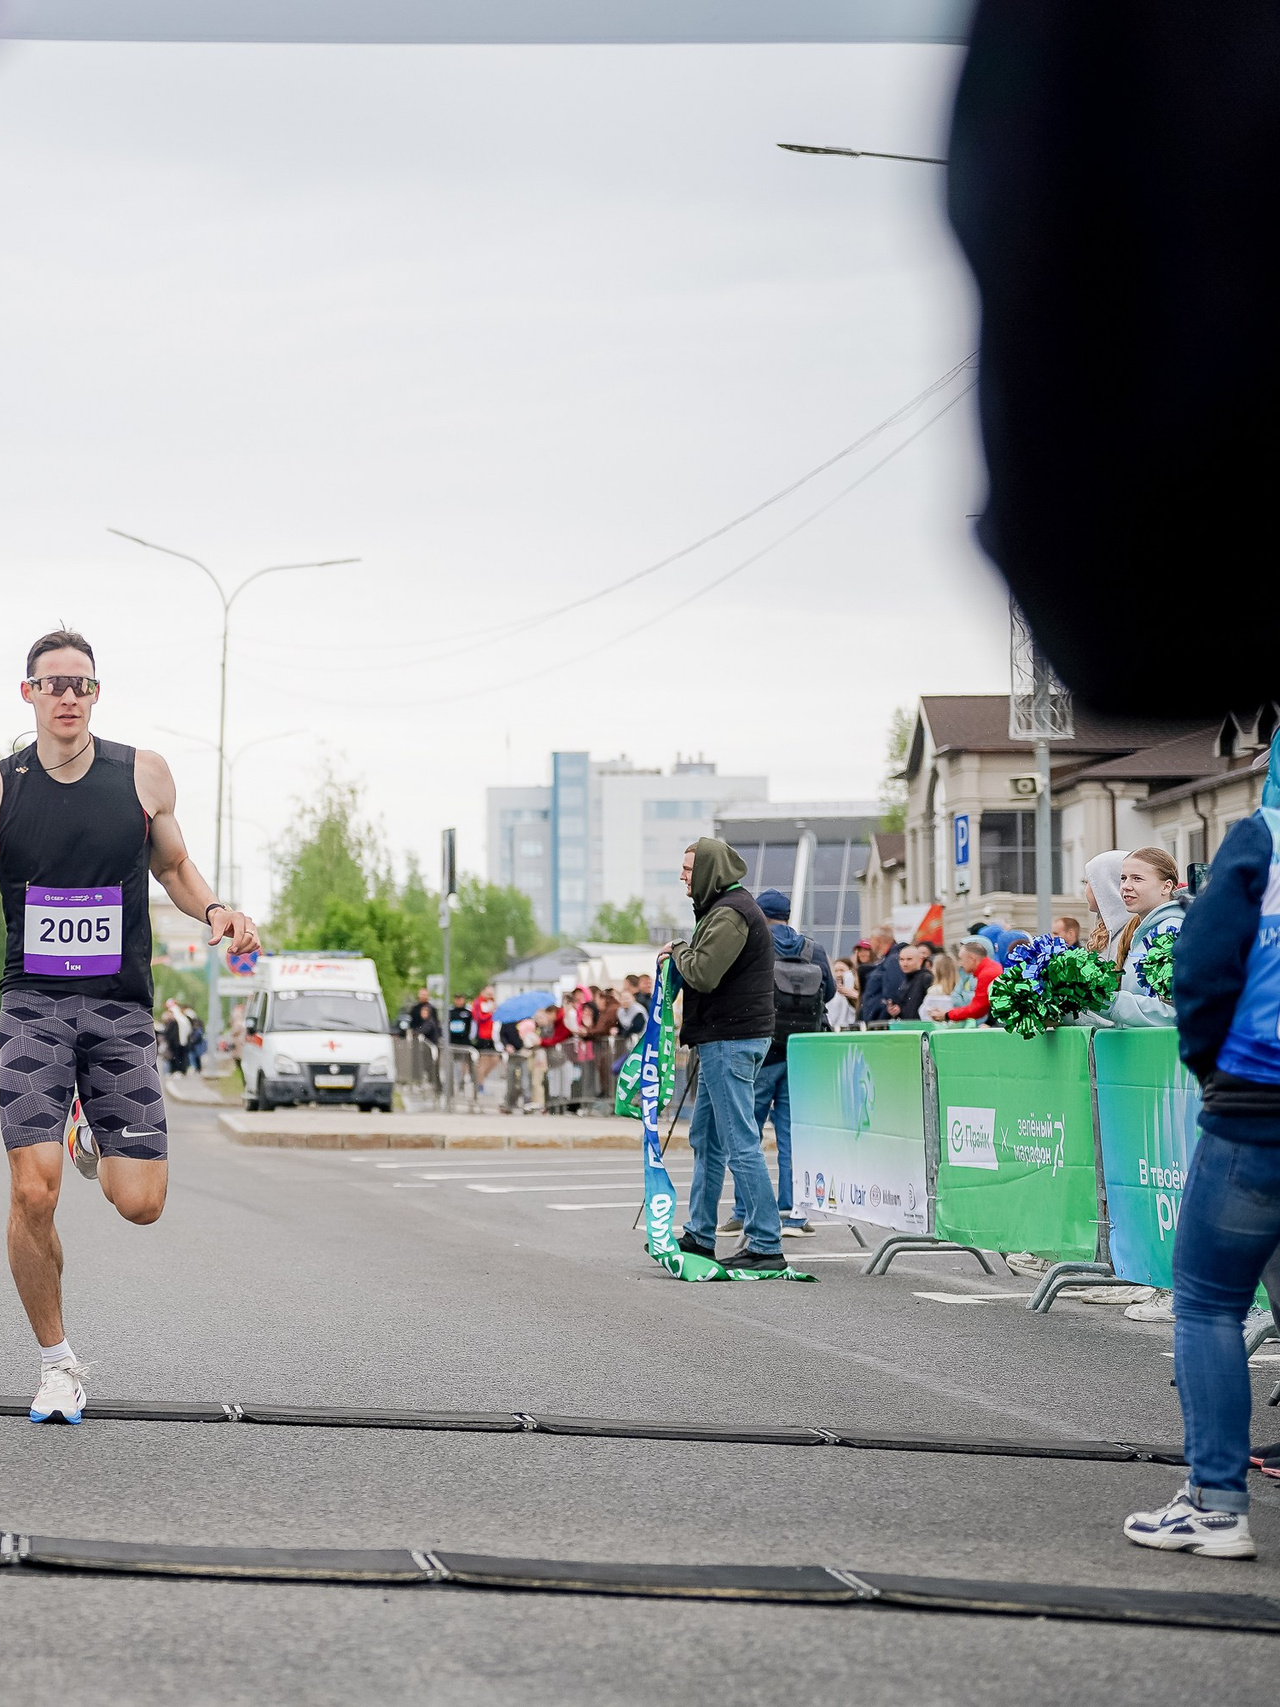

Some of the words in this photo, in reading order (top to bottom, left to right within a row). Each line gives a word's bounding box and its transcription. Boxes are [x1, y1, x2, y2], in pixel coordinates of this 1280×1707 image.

[957, 819, 969, 862] P
[39, 917, 110, 944] 2005
[965, 1124, 991, 1154] Прайм
[1016, 1112, 1053, 1139] зелёный
[1013, 1139, 1052, 1169] марафон
[1138, 1158, 1149, 1186] В
